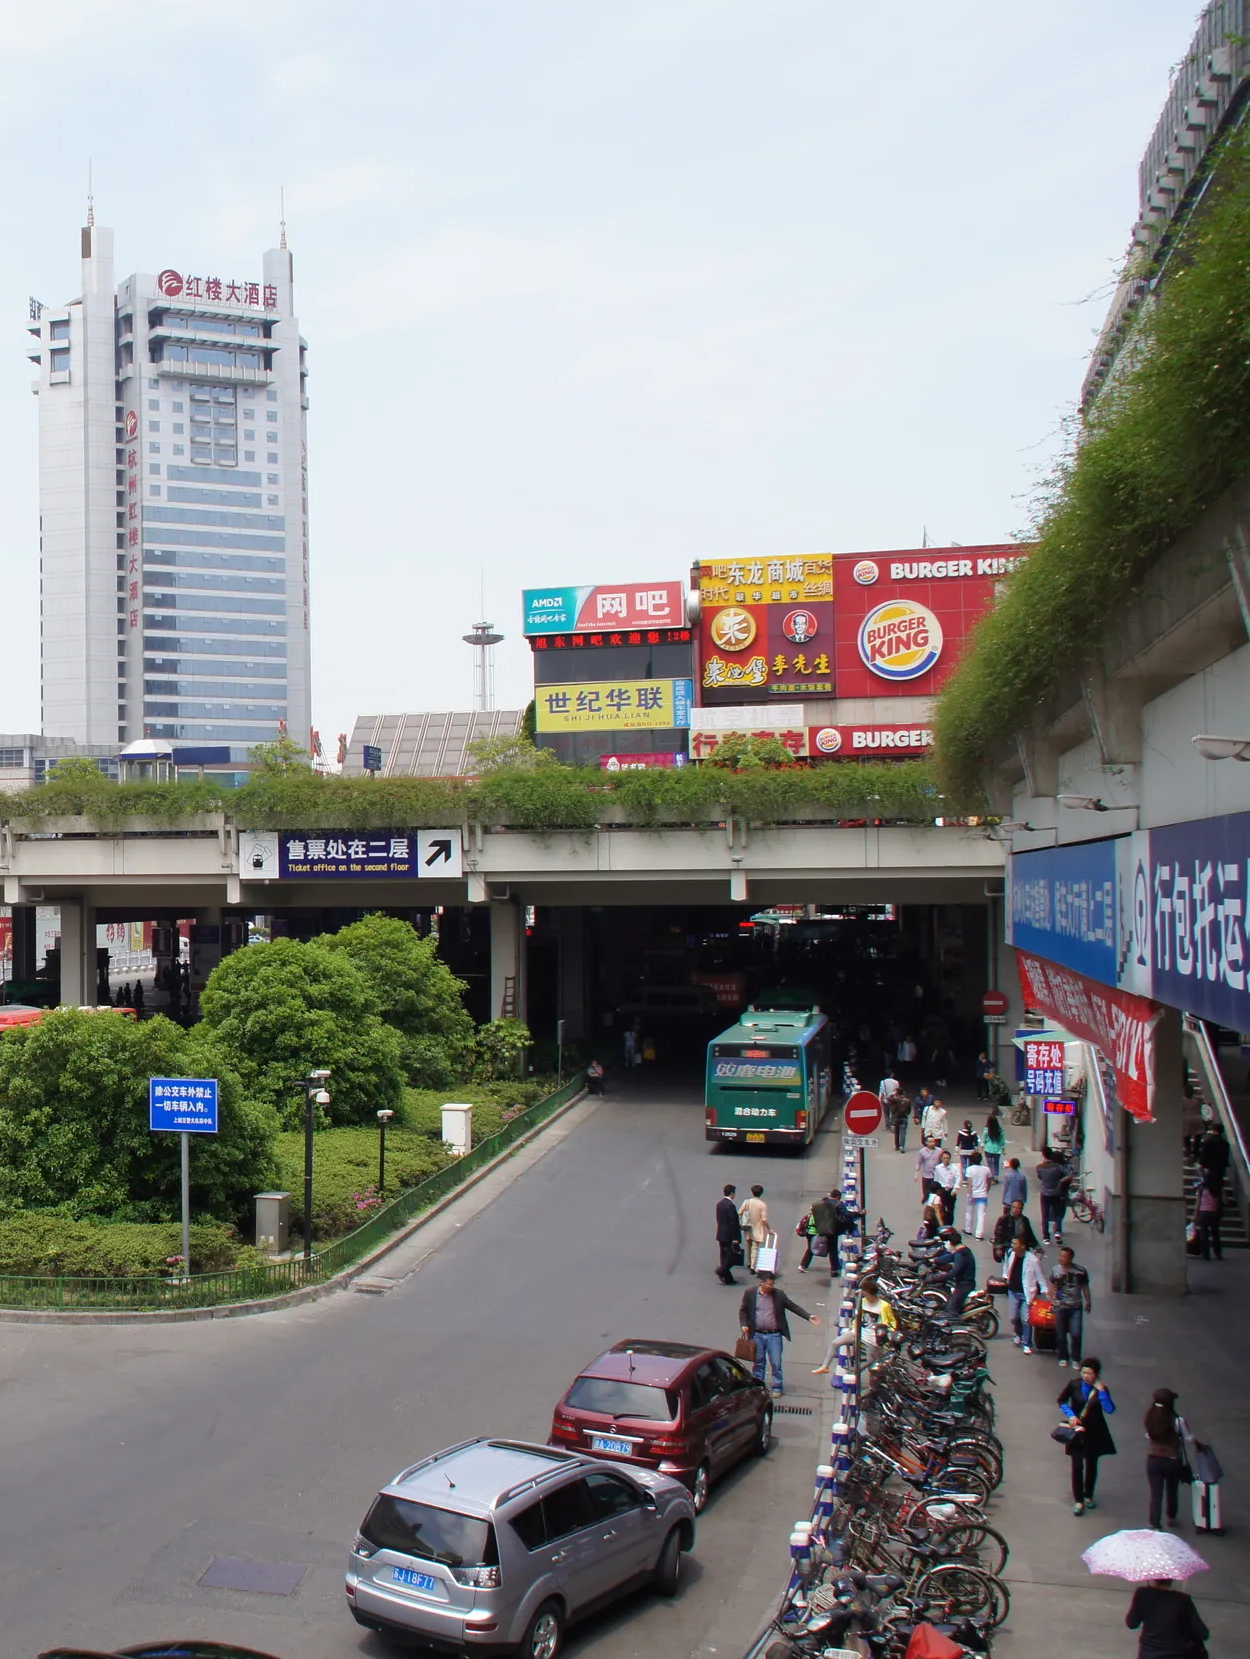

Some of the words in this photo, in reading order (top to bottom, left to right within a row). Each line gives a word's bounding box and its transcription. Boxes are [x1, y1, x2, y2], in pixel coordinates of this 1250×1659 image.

[186, 274, 278, 308] 红楼大酒店
[127, 449, 139, 629] 杭州红楼大酒店
[727, 559, 804, 585] 东龙商城
[803, 560, 832, 575] 百货
[890, 560, 973, 580] BURGER
[700, 586, 729, 601] 时代
[735, 590, 799, 602] 联华超市
[803, 581, 832, 597] 丝绸
[532, 597, 556, 608] AMD
[596, 590, 670, 618] 网吧
[867, 616, 926, 645] BURGER
[870, 629, 929, 664] KING
[771, 653, 831, 676] 李先生
[545, 686, 663, 714] 世纪华联
[853, 730, 934, 748] BURGER
[286, 838, 410, 860] 售票处在二层
[288, 864, 311, 873] Ticket
[313, 864, 335, 873] office
[350, 864, 362, 873] the
[364, 864, 387, 873] second
[390, 863, 410, 872] floor
[1154, 857, 1250, 994] 行包托运
[1026, 1043, 1062, 1068] 寄存处
[154, 1086, 212, 1099] 除公交车外禁止
[1026, 1069, 1062, 1094] 号码充值
